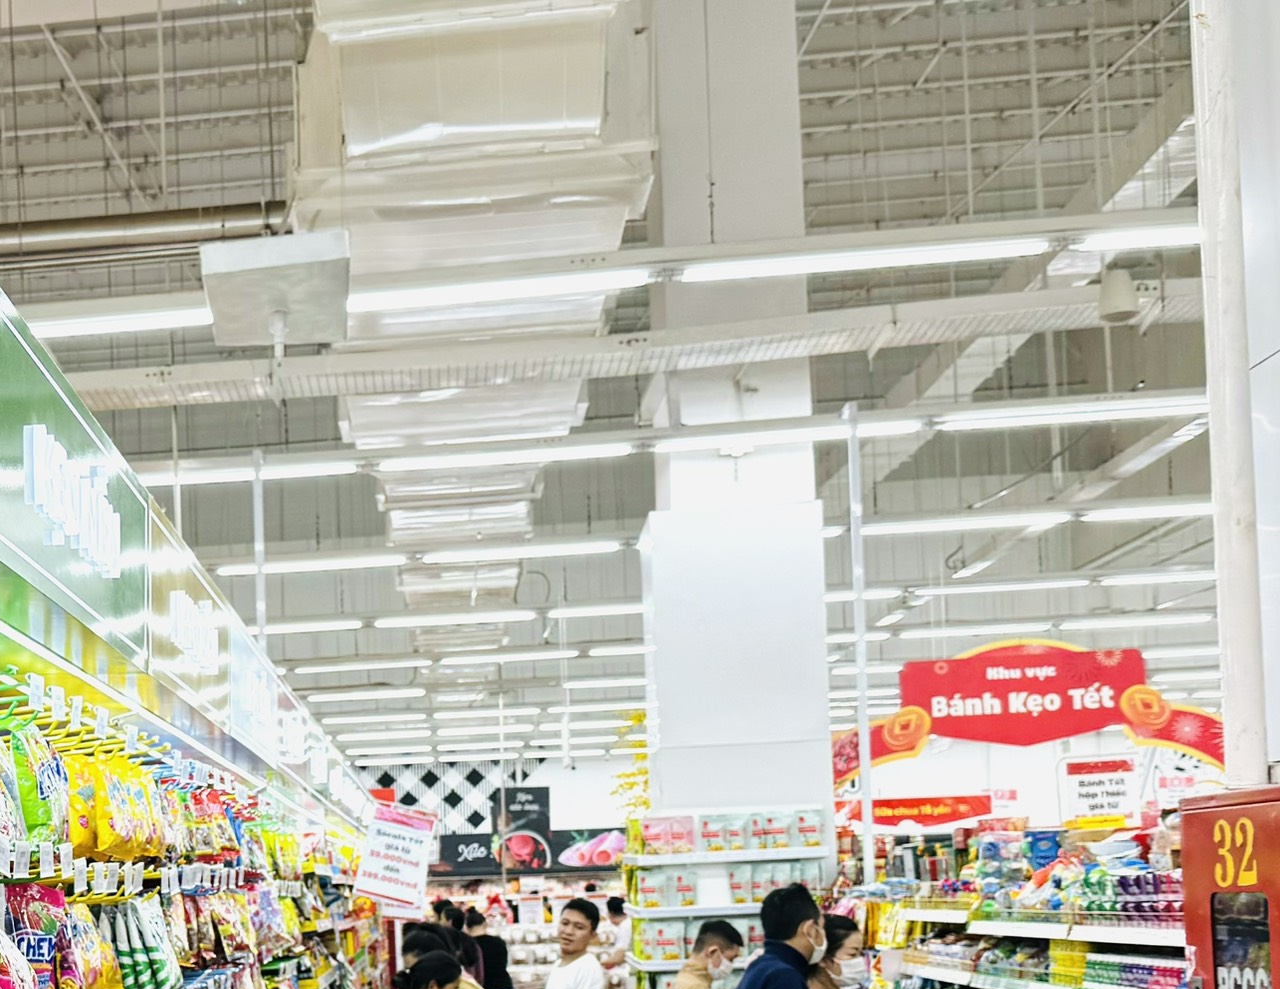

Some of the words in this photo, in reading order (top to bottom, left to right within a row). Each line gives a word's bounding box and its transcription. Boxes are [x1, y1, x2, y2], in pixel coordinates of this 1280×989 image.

[986, 665, 1020, 681] Khu
[1024, 665, 1057, 682] vực
[931, 690, 1002, 719] Bánh
[1008, 690, 1061, 718] Kẹo
[1068, 681, 1115, 711] Tết
[1213, 816, 1258, 888] 32
